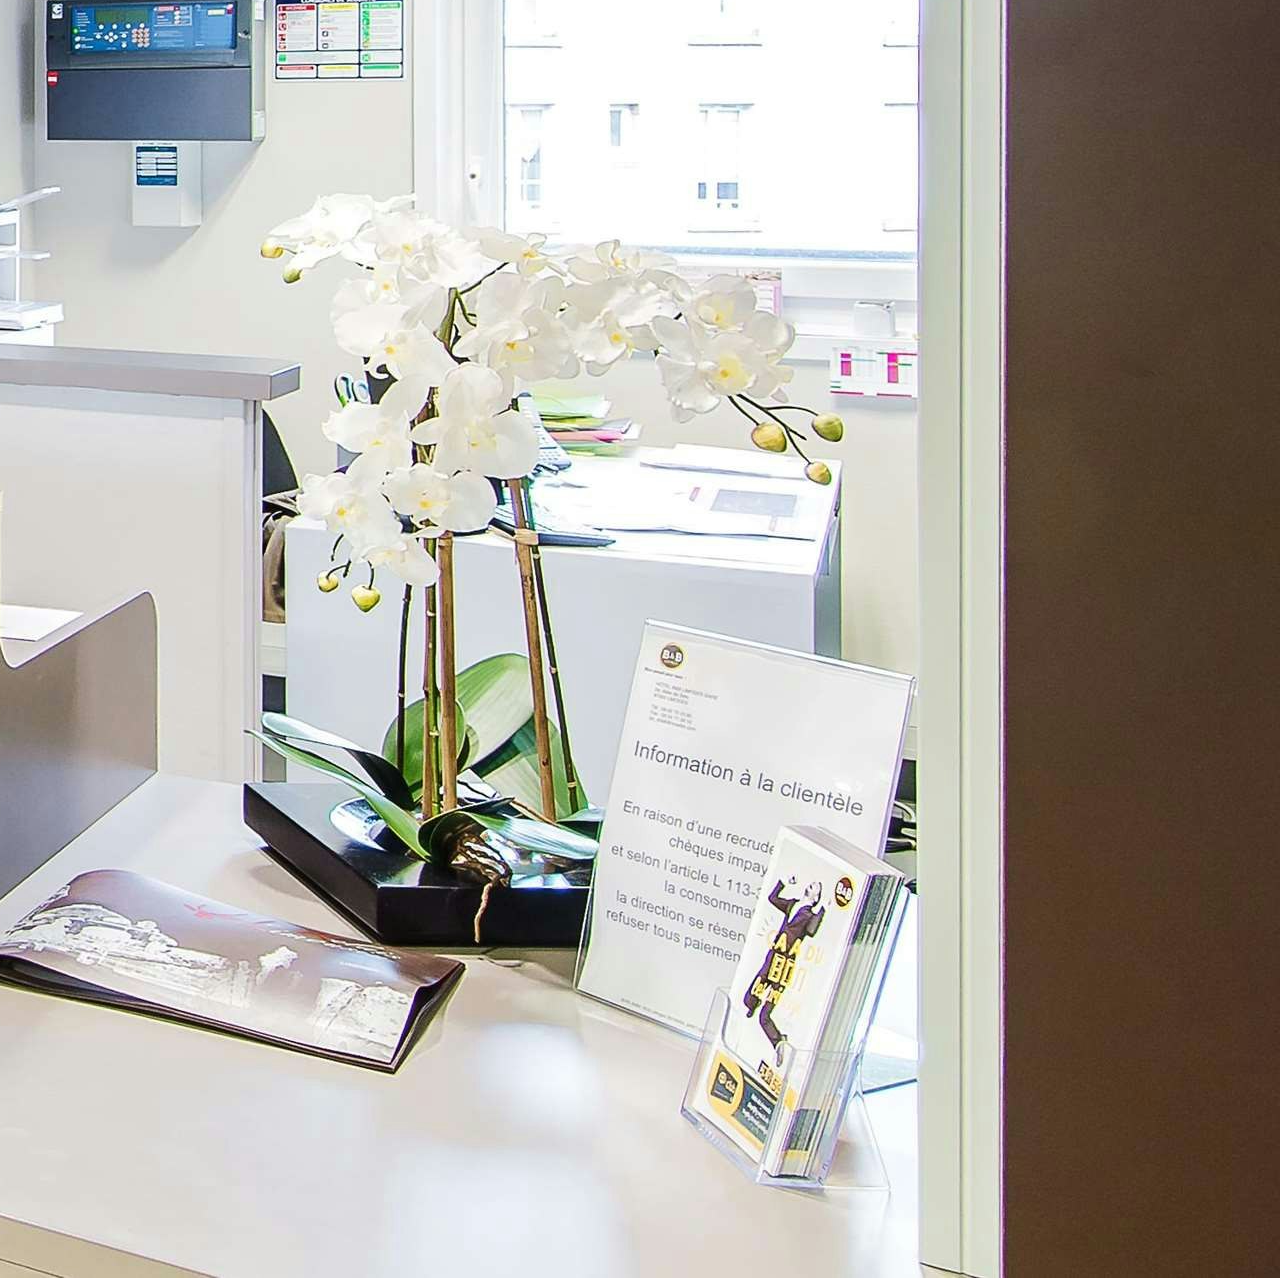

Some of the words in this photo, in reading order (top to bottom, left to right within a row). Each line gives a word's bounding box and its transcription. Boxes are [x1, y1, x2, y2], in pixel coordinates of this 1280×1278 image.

[662, 649, 683, 663] B&B
[633, 740, 734, 782] Information
[739, 769, 751, 786] à
[757, 773, 774, 792] la
[780, 781, 864, 816] clientèle
[623, 800, 641, 816] En
[643, 808, 682, 828] raison
[686, 820, 722, 839] d'une
[611, 844, 624, 857] et
[626, 849, 660, 868] selon
[663, 859, 709, 884] l'article
[713, 875, 721, 888] L
[669, 836, 724, 863] chèques
[664, 880, 676, 895] la
[606, 910, 650, 932] refuser
[653, 924, 681, 943] tous
[616, 890, 627, 904] la
[631, 896, 685, 924] direction
[688, 917, 704, 930] se
